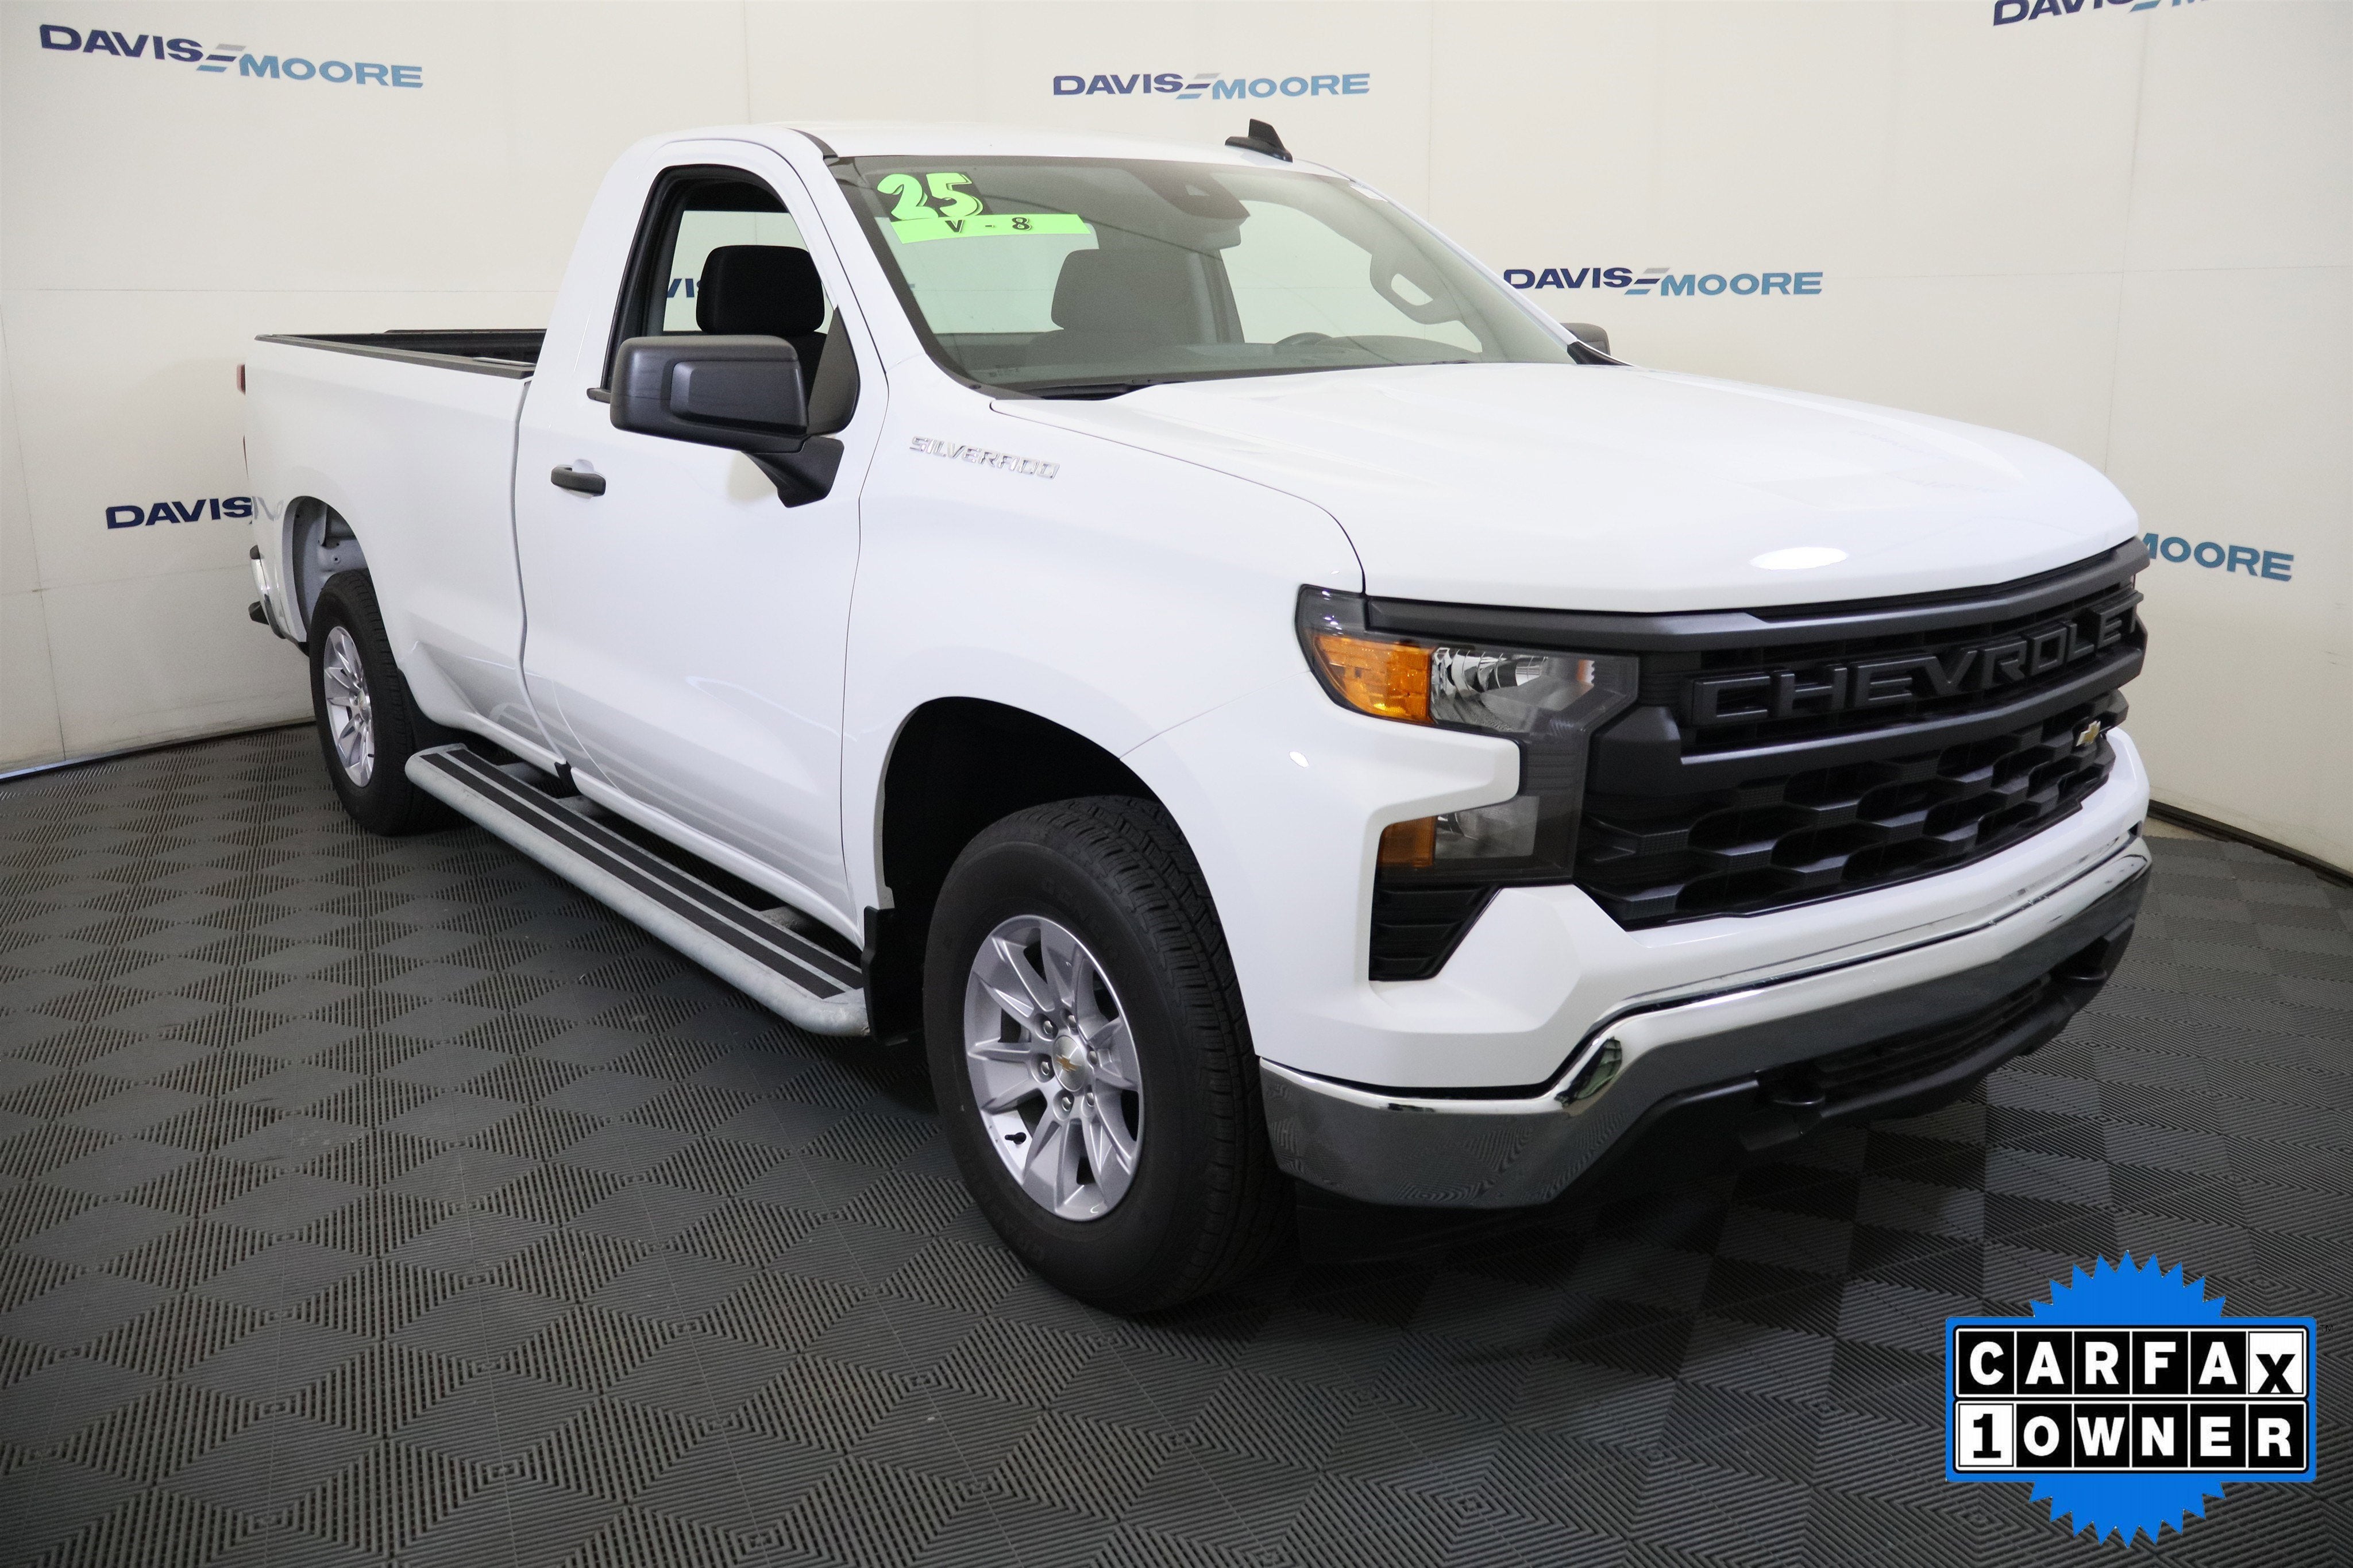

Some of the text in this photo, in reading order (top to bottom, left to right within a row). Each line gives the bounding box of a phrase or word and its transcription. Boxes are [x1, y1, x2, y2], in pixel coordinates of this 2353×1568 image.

[1993, 0, 2134, 26] DAV
[39, 23, 423, 88] DAVIS MOORE
[1054, 73, 1370, 100] DAVIS MOORE
[877, 172, 983, 221] 25
[1504, 267, 1823, 296] DAVIS MOORE
[909, 435, 1061, 480] SILVERADO
[106, 496, 252, 530] DAVIS
[1691, 588, 2144, 725] CHEVROLET
